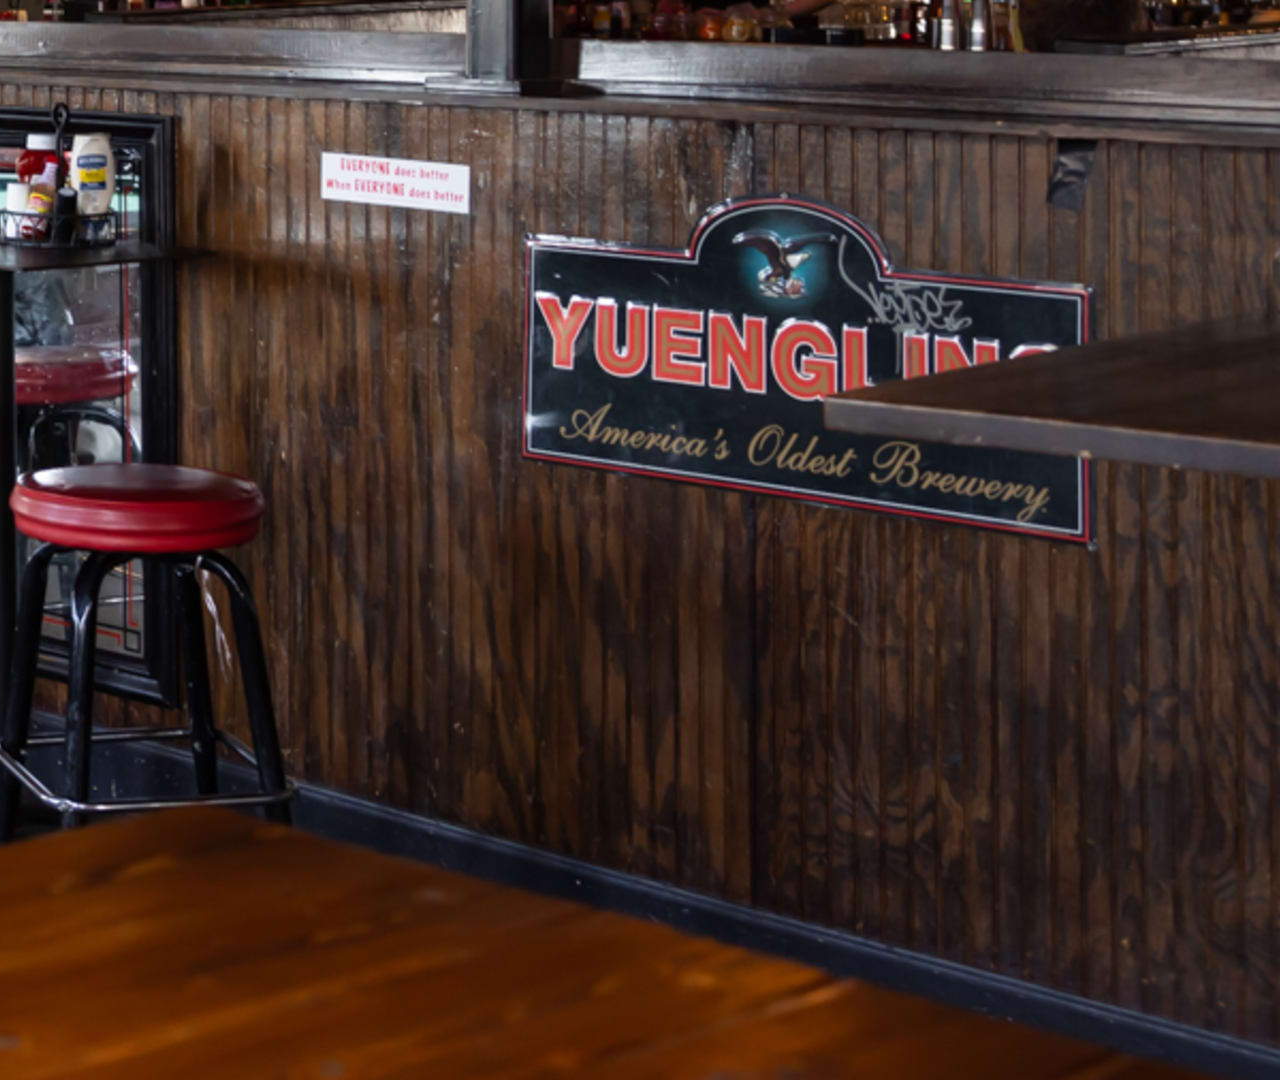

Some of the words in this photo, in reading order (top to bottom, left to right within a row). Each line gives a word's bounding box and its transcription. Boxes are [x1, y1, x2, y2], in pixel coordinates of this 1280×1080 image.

[340, 158, 391, 175] EVERYONE
[394, 165, 416, 178] does
[419, 168, 449, 181] better
[354, 178, 405, 197] EVERYONE
[409, 187, 431, 200] does
[434, 189, 464, 204] better
[559, 402, 732, 462] America's
[746, 423, 856, 479] Oldest
